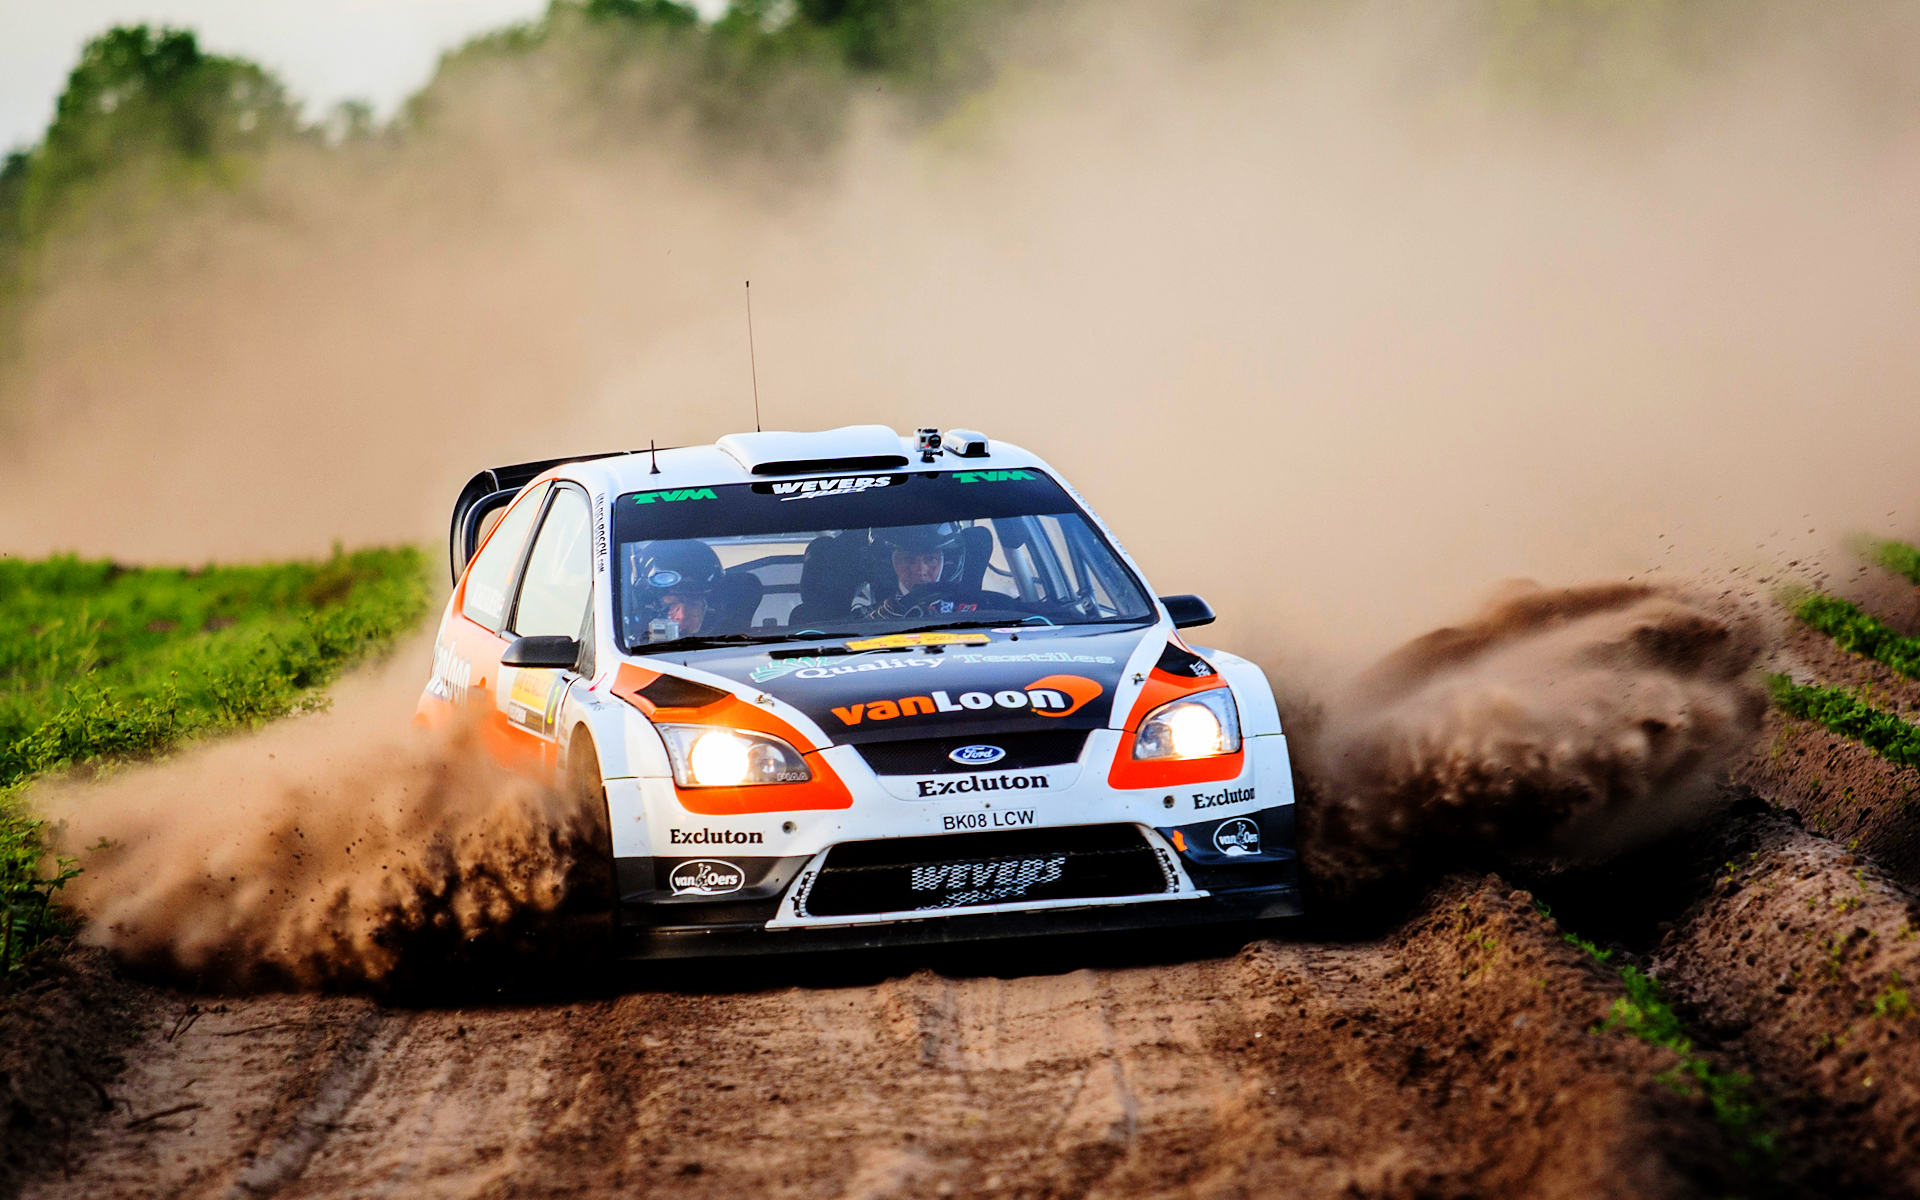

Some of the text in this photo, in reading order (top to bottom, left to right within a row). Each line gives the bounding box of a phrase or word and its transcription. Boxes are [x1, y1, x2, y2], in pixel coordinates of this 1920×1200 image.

[953, 470, 1036, 483] TVM
[772, 476, 892, 495] WEVERS
[631, 488, 718, 505] TVM
[795, 652, 1116, 679] Quality Textiles
[831, 690, 1065, 726] vanLoon
[962, 747, 994, 759] Ford
[776, 771, 808, 781] PIAA
[916, 775, 1049, 797] Excluton
[943, 810, 1034, 830] BK08 LCW
[670, 828, 763, 844] Excluton
[1219, 835, 1237, 845] van
[674, 872, 738, 887] van Oers
